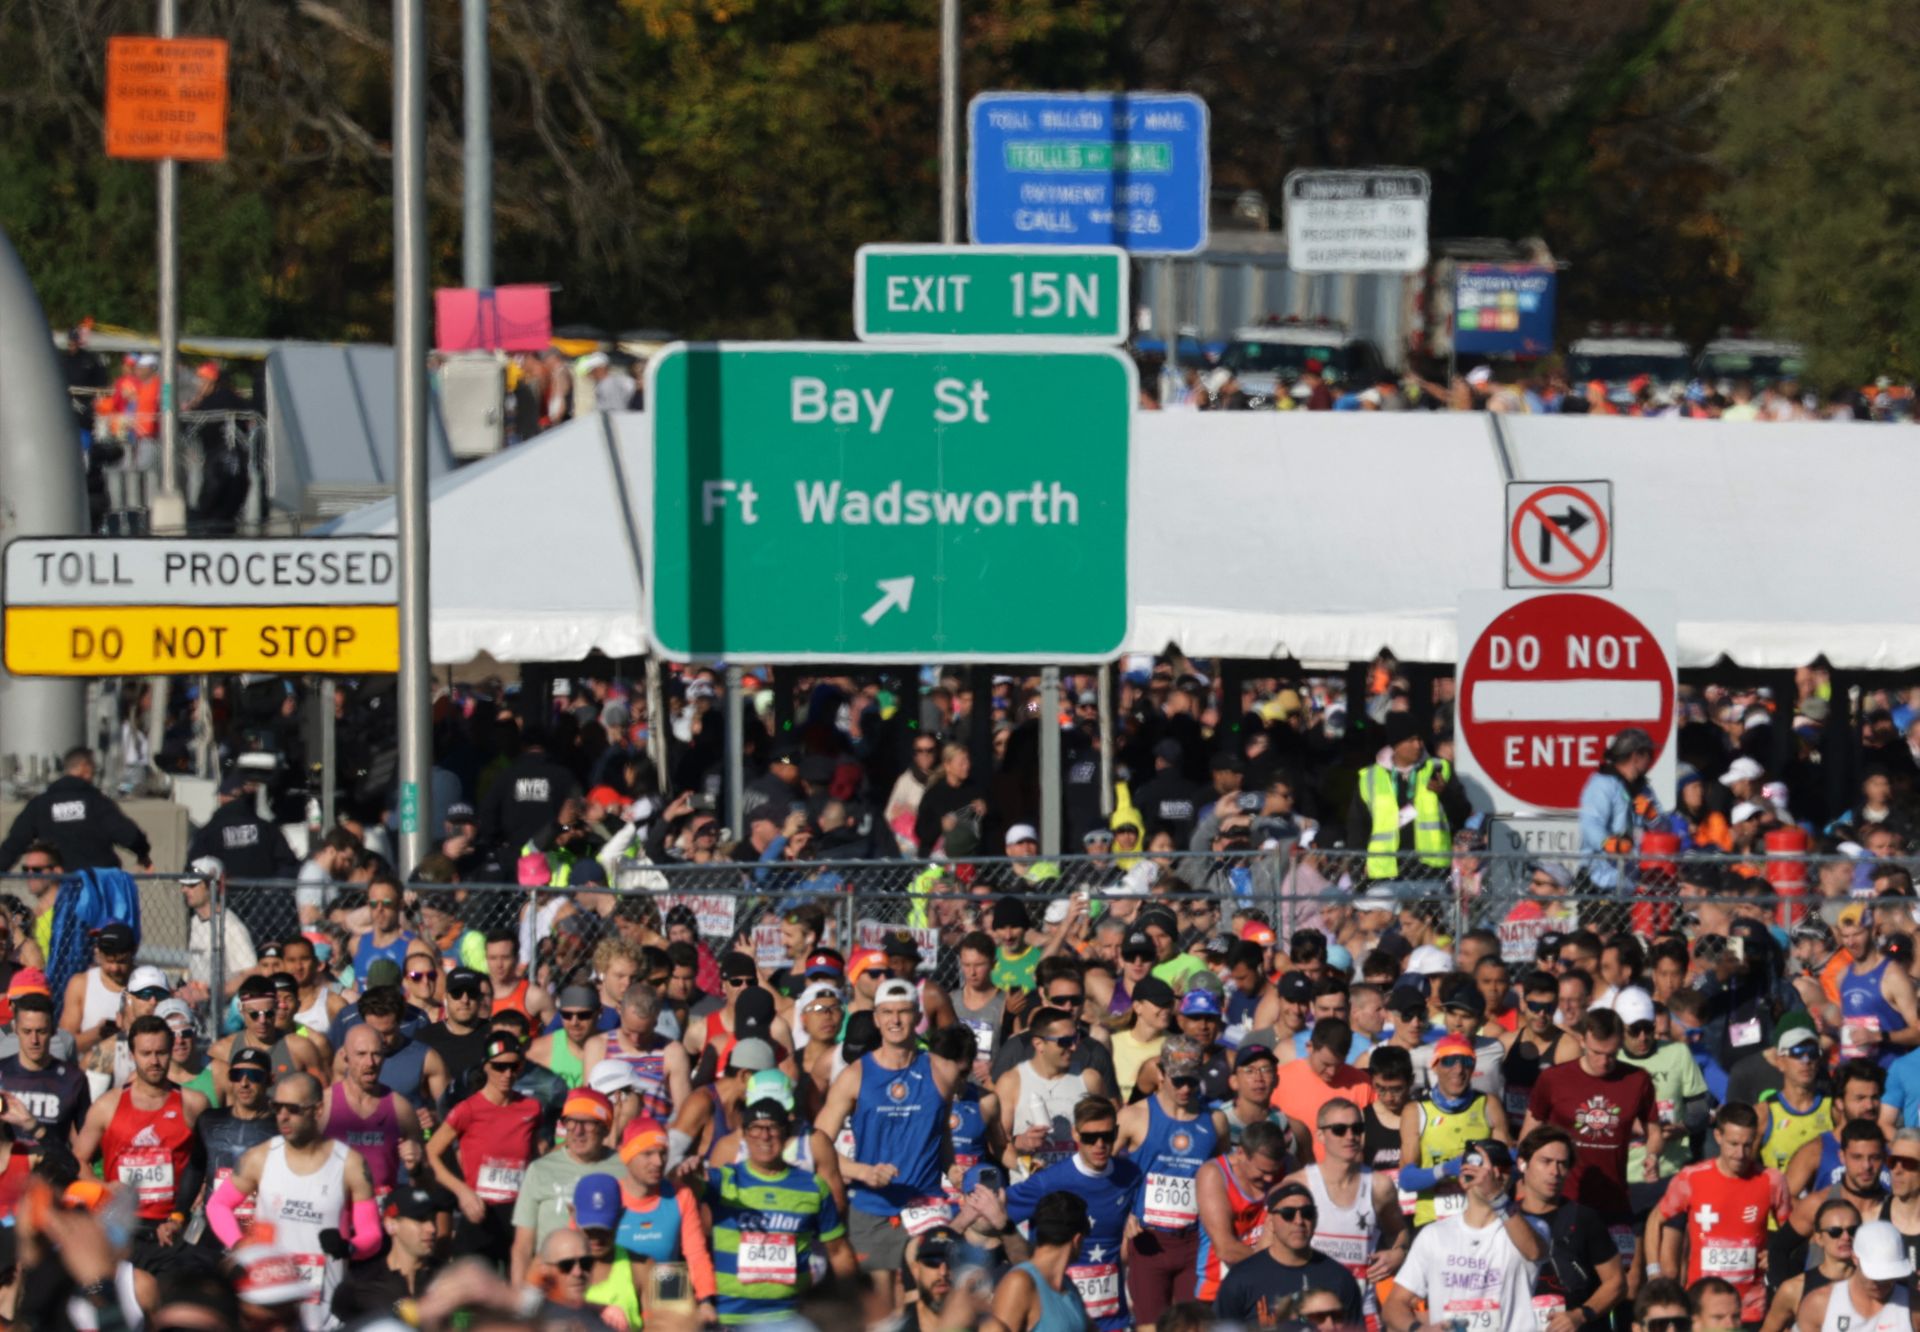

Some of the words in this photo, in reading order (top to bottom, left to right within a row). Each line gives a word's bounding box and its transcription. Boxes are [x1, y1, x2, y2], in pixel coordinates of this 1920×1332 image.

[1009, 144, 1083, 168] TOLLS
[1021, 183, 1105, 204] PAYMENT
[1014, 209, 1078, 232] CALL
[886, 275, 971, 313] EXIT
[1009, 271, 1100, 319] 15N
[790, 376, 894, 434] Bay
[933, 377, 991, 425] St
[702, 480, 759, 526] Ft
[795, 479, 1079, 526] Wadsworth
[35, 551, 133, 586] TOLL
[165, 551, 394, 586] PROCESSED
[70, 626, 124, 661] DO
[152, 626, 229, 660] NOT
[259, 625, 357, 658] STOP
[1489, 635, 1541, 671] DO
[1567, 634, 1643, 669] NOT
[515, 777, 550, 798] NYPD
[126, 1165, 165, 1183] 7646
[1156, 1175, 1191, 1191] MAX
[285, 1199, 314, 1211] PIECE
[1154, 1187, 1191, 1207] 6100
[281, 1206, 295, 1216] OF
[296, 1209, 324, 1220] CAKE
[746, 1245, 788, 1262] 6420
[1708, 1250, 1749, 1266] 8324
